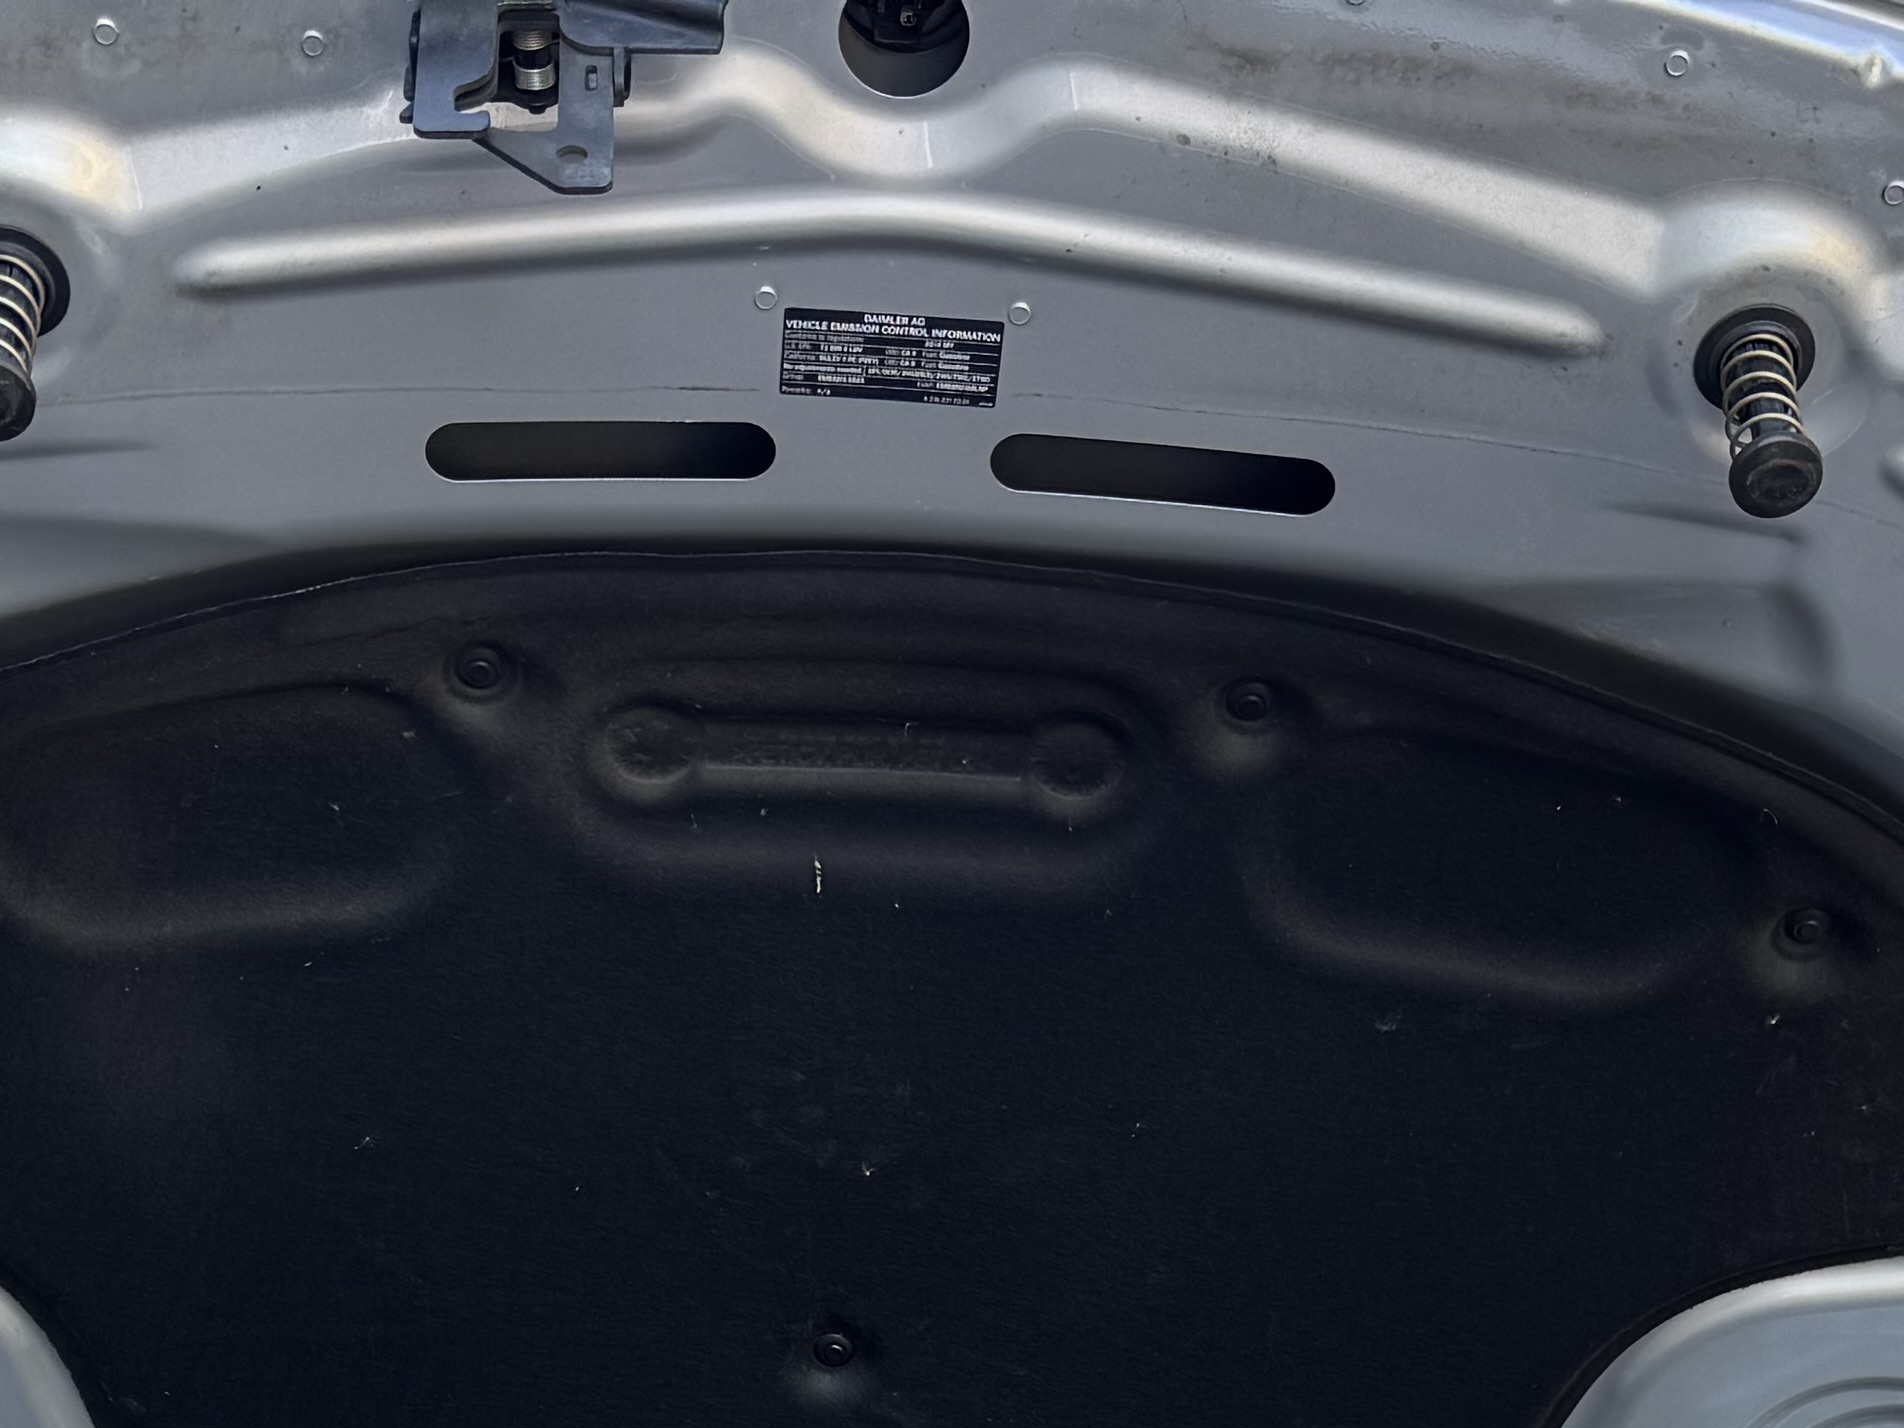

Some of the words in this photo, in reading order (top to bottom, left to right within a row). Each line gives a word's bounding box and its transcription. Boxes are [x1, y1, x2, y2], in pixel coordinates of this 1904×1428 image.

[864, 313, 909, 326] DAIMLER
[911, 317, 926, 326] AG
[786, 319, 828, 331] VEHICLE
[830, 321, 880, 334] EMISSION
[881, 325, 929, 337] CONTROL
[931, 328, 1001, 342] INFORMATION
